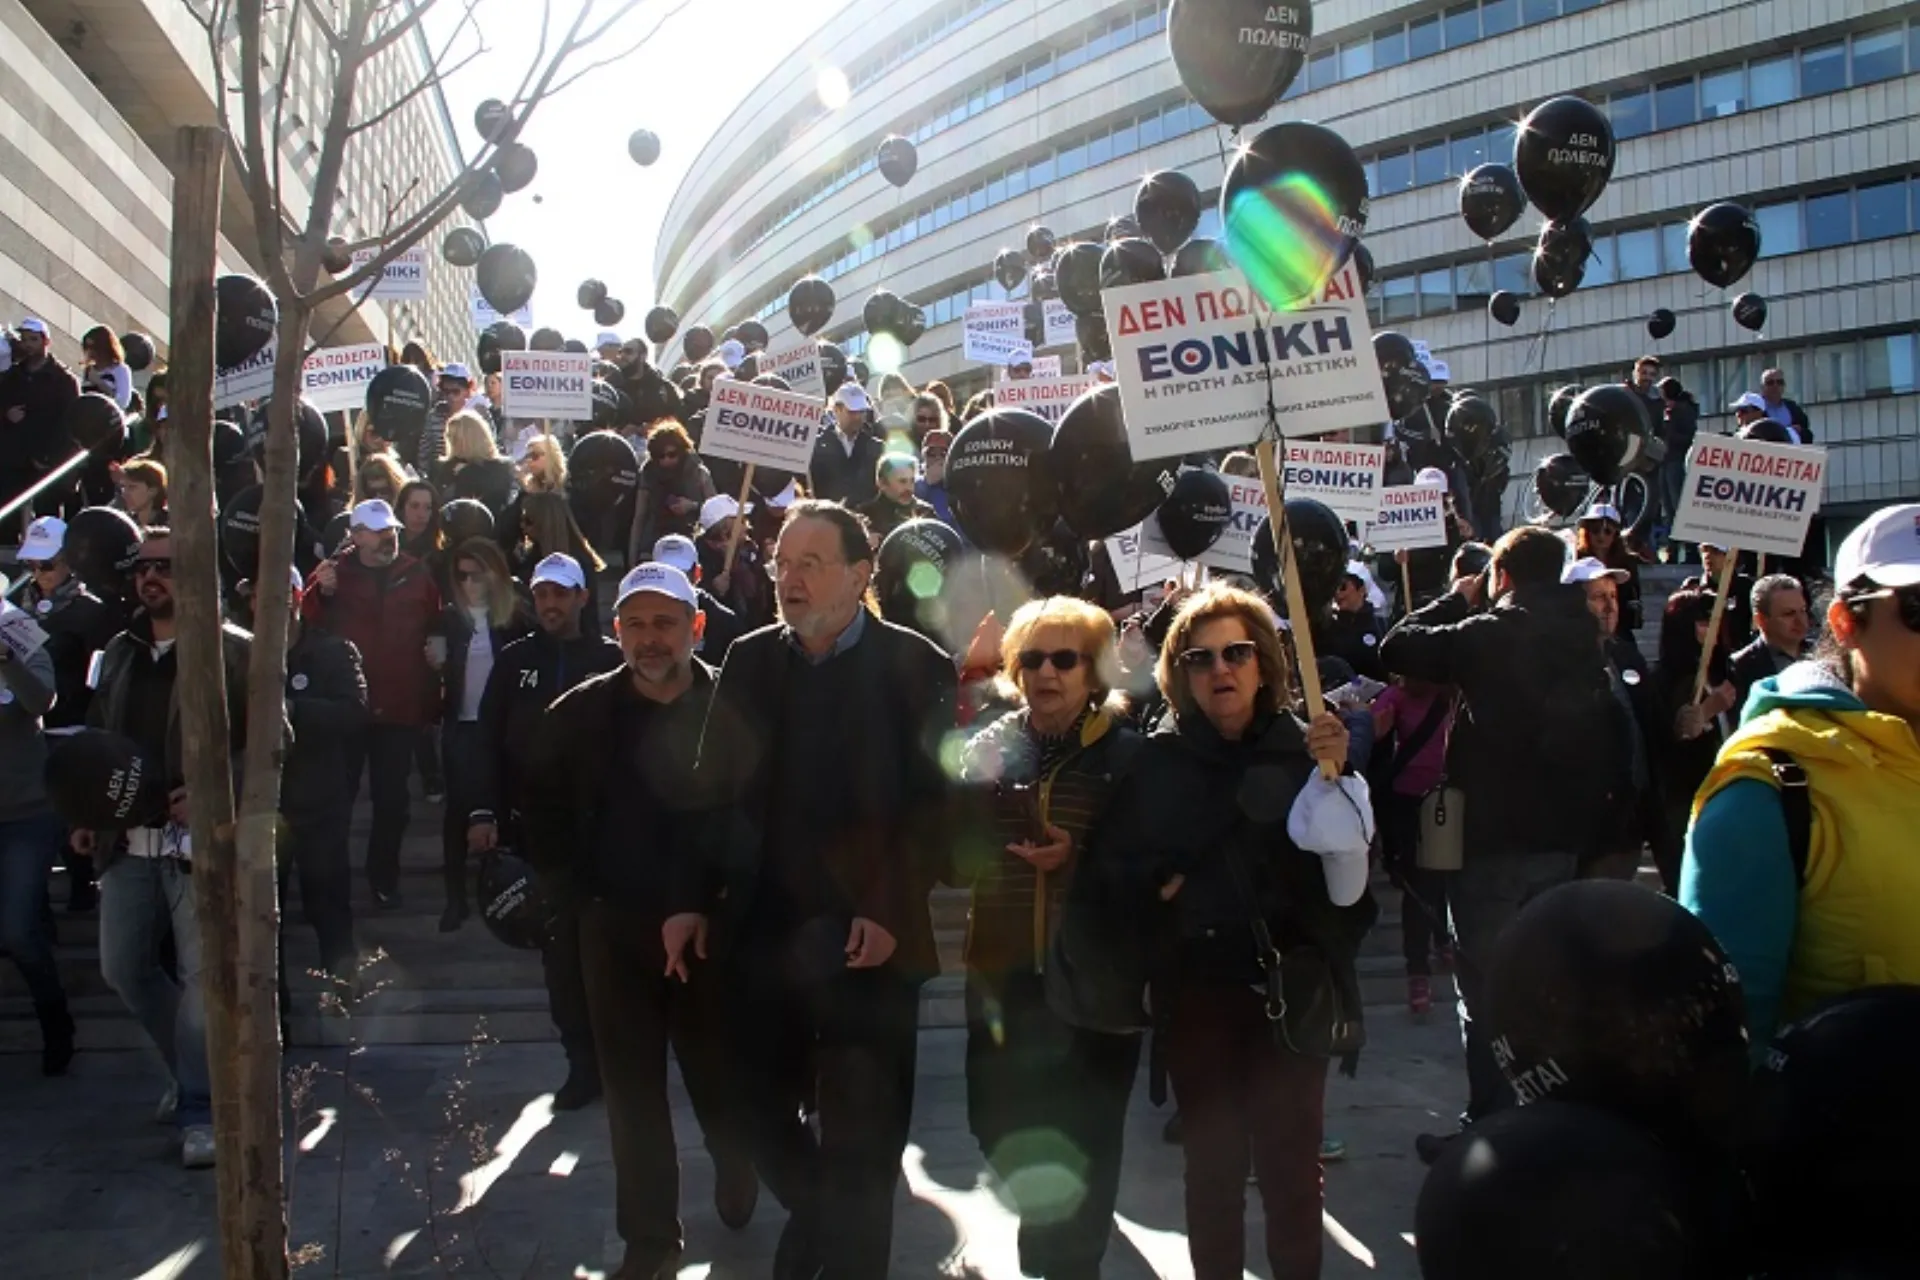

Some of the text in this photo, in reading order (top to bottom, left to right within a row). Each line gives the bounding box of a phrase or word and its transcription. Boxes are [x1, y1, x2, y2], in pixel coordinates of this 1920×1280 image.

[1265, 5, 1300, 26] ΔΕΝ
[1568, 132, 1597, 148] ΔΕΝ
[381, 265, 421, 279] ΝΙΚΗ
[1118, 270, 1355, 337] ΔΕΝ ΠΩΛΑΙ
[1137, 316, 1352, 383] ΕΘΝΙΚΗ
[306, 366, 380, 389] ΕΘΝΙΚΗ
[510, 376, 585, 392] ΕΘΝΙΚΗ
[1144, 387, 1157, 400] Η
[1162, 376, 1226, 397] ΠΡΩΤΗ
[717, 388, 822, 422] ΔΕΝ ΠΩΛΕΙΤΑΙ
[998, 387, 1026, 404] ΔΕΝ
[717, 407, 810, 443] ΕΘΝΙΚΗ
[1312, 448, 1382, 468] ΠΩΛΕΙΤΑΙ
[1695, 446, 1822, 482] ΔΕΝ ΠΩΛΕΙΤΑΙ
[1285, 467, 1374, 490] ΕΘΝΙΚΗ
[1695, 475, 1807, 512] ΕΘΝΙΚΗ
[519, 669, 539, 689] 74
[106, 767, 125, 801] ΔΕΝ
